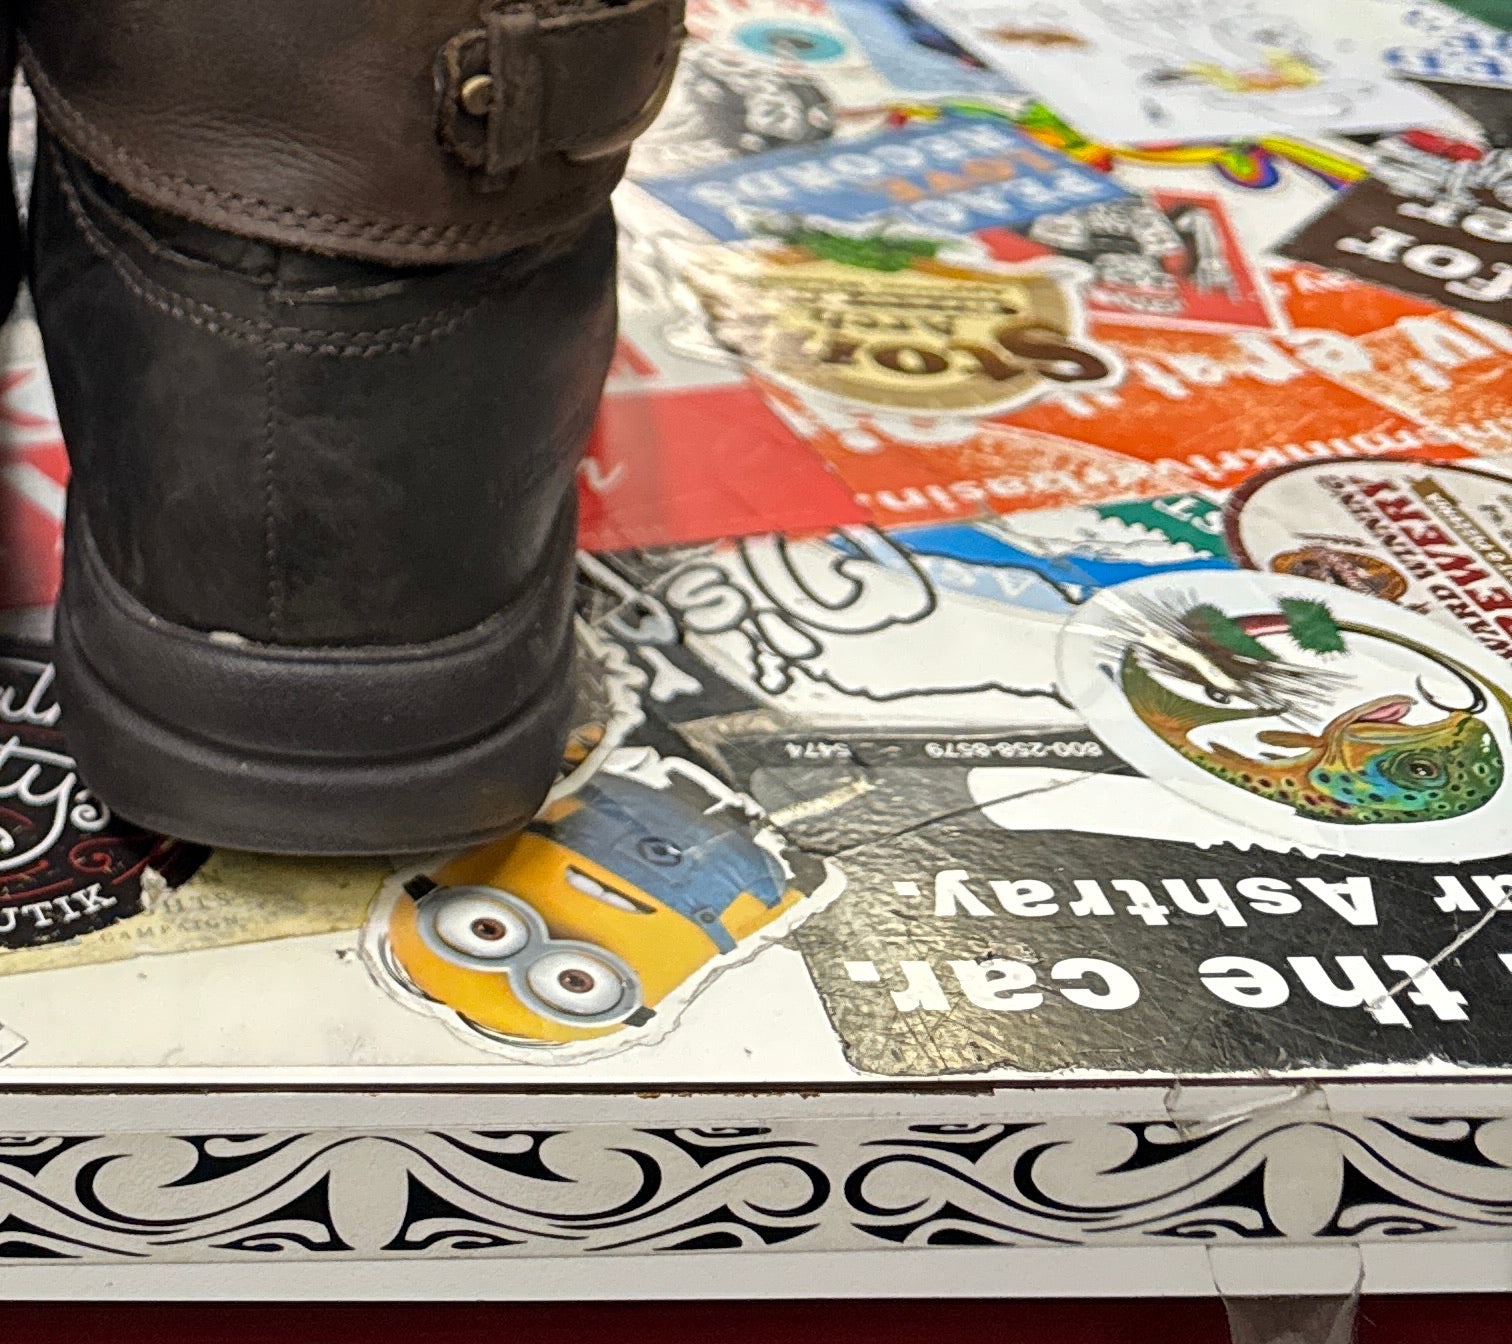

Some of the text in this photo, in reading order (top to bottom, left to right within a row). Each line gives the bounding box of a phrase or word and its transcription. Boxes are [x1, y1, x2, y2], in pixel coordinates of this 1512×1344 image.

[892, 869, 1379, 927] Ashtray.
[844, 953, 1467, 1028] the car.
